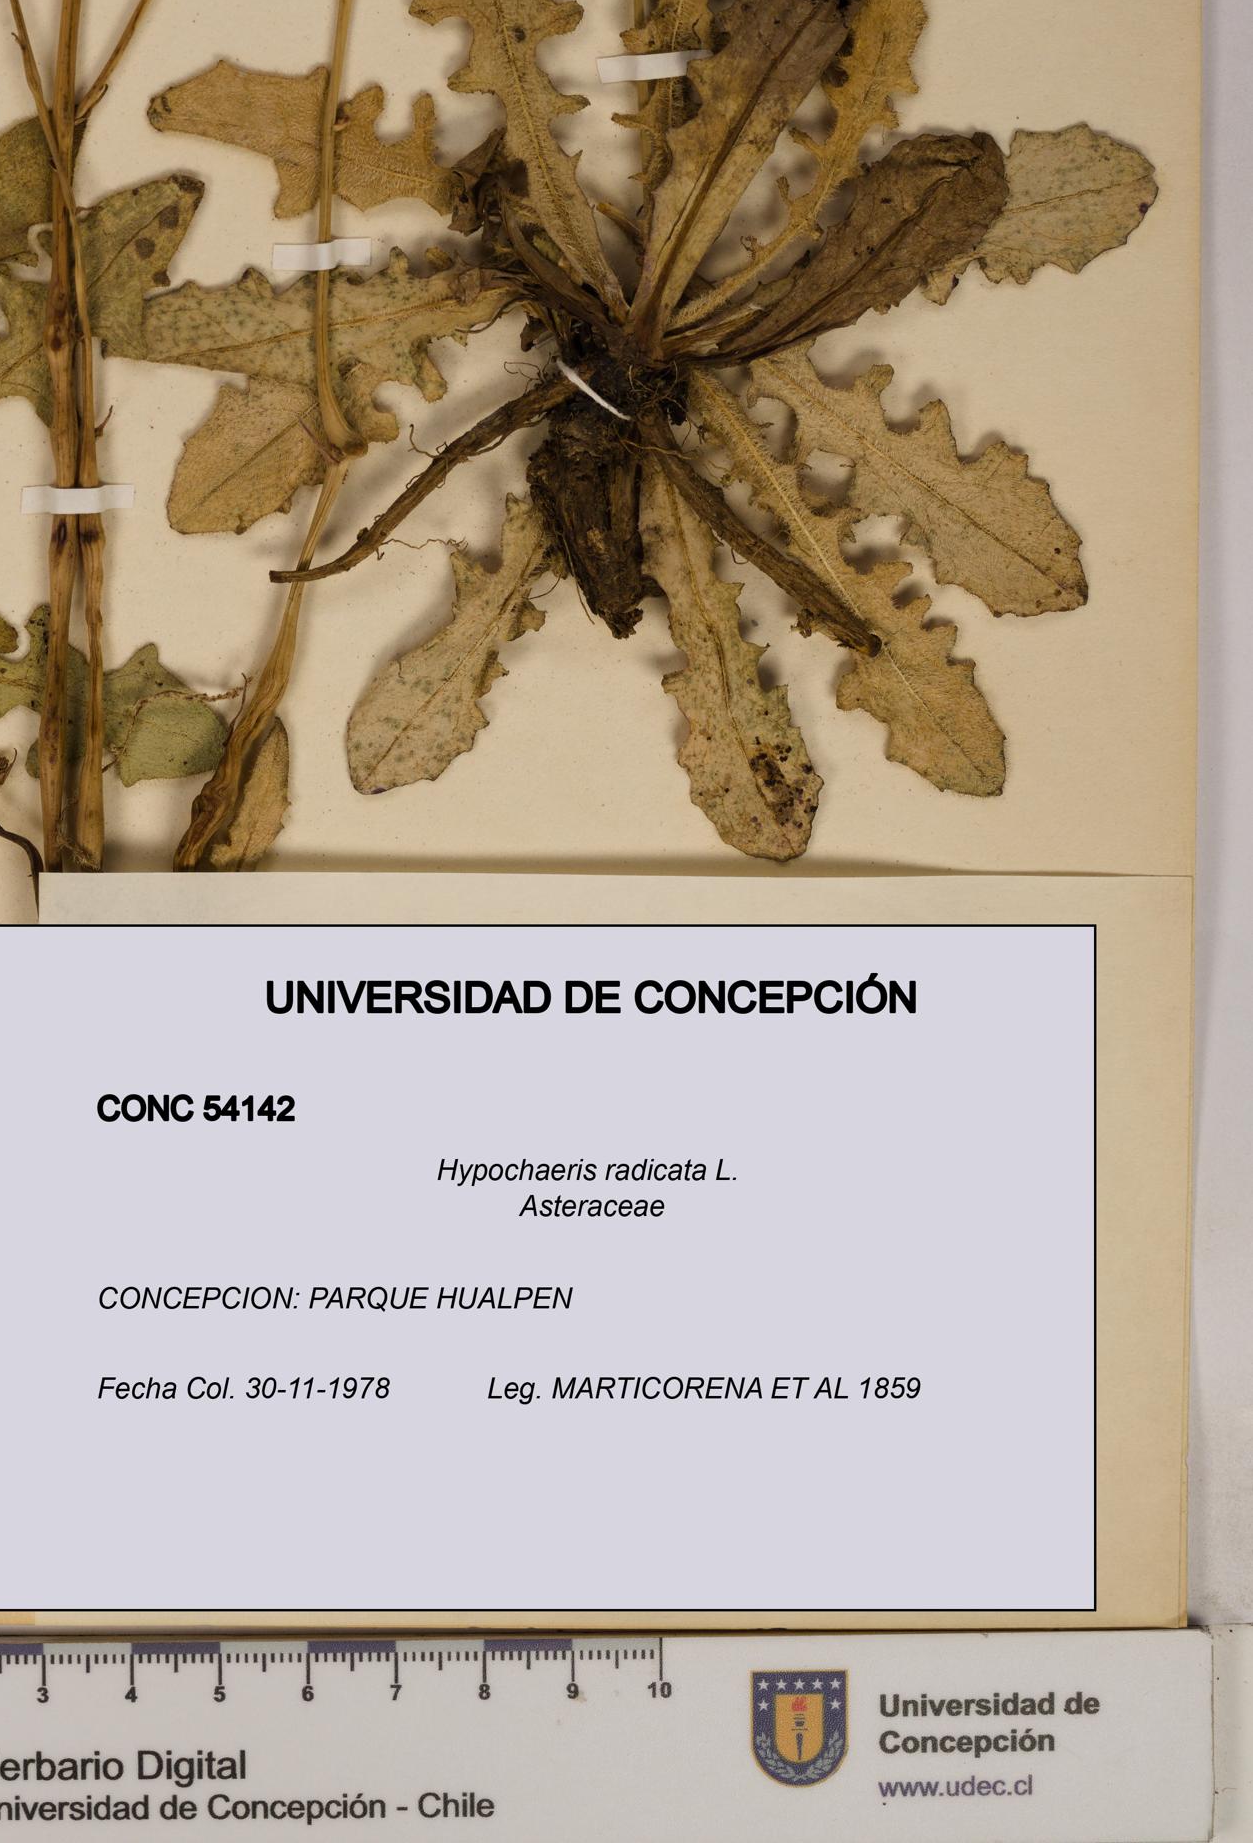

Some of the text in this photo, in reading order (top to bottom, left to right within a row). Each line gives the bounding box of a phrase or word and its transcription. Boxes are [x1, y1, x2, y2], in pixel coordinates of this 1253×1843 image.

[36, 1686, 50, 1704] 3
[124, 1686, 138, 1703] 4
[213, 1686, 226, 1703] 5
[301, 1685, 315, 1702] 6
[389, 1684, 403, 1701] 7
[478, 1683, 491, 1701] 8
[566, 1682, 580, 1700] 9
[647, 1681, 672, 1699] 10
[879, 1691, 1101, 1718] Universidad de
[878, 1728, 1055, 1759] Concepción
[137, 1749, 246, 1789] Digital
[879, 1774, 1033, 1798] www.udec.cl
[159, 1794, 198, 1821] de
[207, 1792, 386, 1826] Concepción
[417, 1791, 495, 1819] Chile
